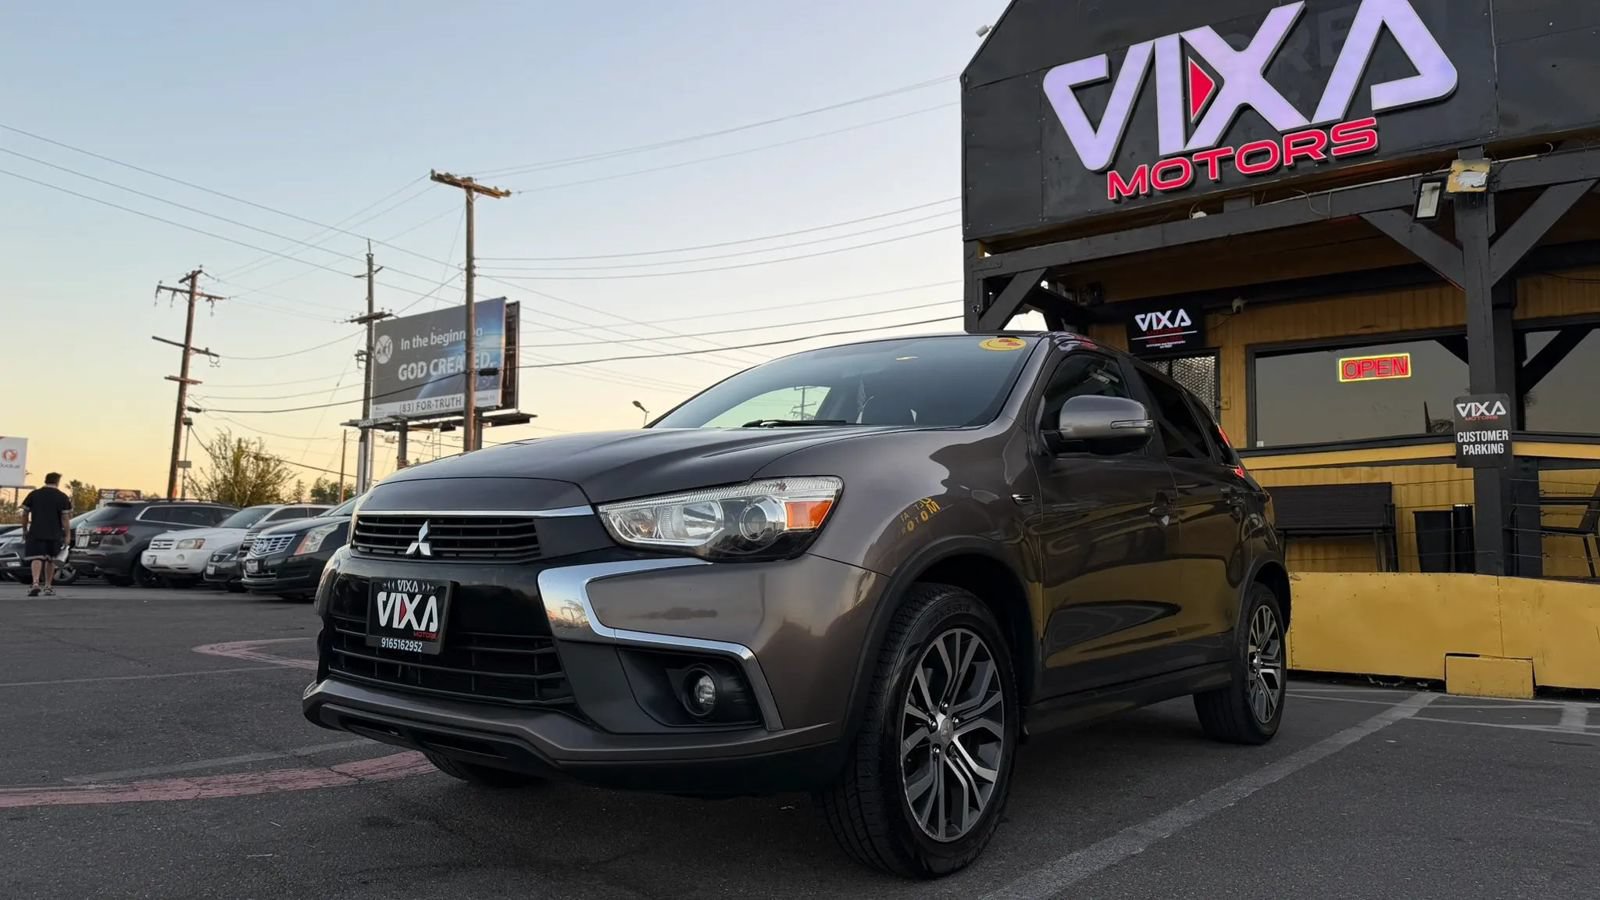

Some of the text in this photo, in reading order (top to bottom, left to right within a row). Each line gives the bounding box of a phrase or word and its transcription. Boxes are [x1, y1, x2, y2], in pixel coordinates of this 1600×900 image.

[1043, 0, 1458, 171] VIXA
[1107, 116, 1378, 200] MOTORS
[1134, 308, 1192, 332] VIXA
[400, 338, 410, 351] In
[412, 334, 428, 348] the
[430, 327, 483, 346] beginng
[398, 361, 427, 380] GOD
[1343, 356, 1409, 379] OPEN
[415, 396, 462, 411] FOR-TRUTH
[1456, 401, 1506, 417] VIXA
[1457, 430, 1509, 443] CUSTOMER
[1463, 443, 1504, 455] PARKING
[397, 580, 419, 593] VIXA
[377, 591, 438, 632] VIXA
[381, 638, 423, 652] 9165162952
